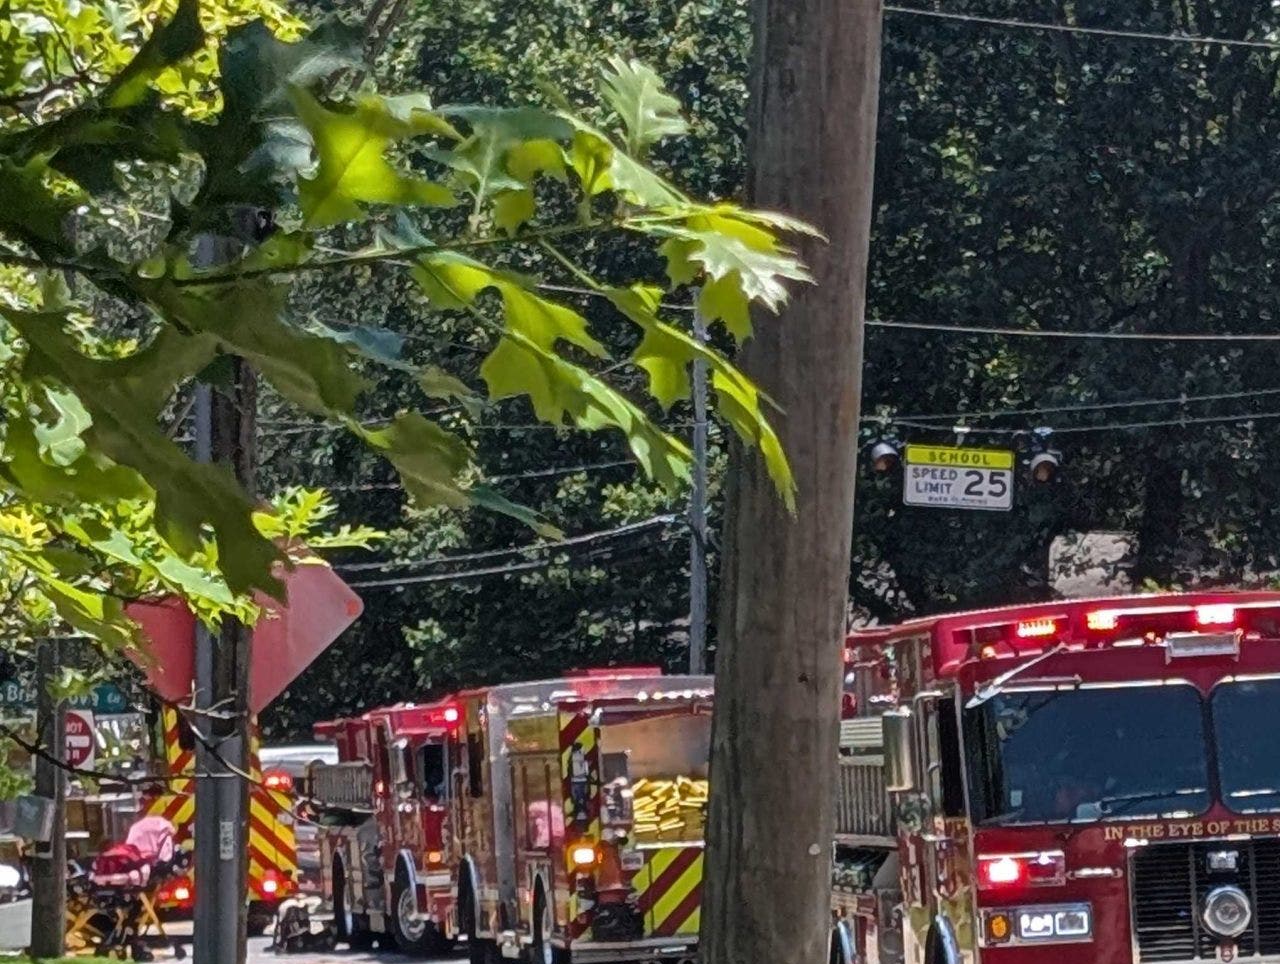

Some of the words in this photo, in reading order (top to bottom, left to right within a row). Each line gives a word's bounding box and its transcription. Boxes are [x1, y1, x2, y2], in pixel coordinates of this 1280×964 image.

[928, 451, 992, 465] SCHOOL
[912, 467, 958, 481] SPEED
[915, 481, 953, 495] LIMIT
[964, 470, 1007, 498] 25
[1104, 826, 1124, 841] IN
[1127, 824, 1164, 839] THE
[1168, 822, 1204, 837] EYE
[1207, 820, 1231, 835] OF
[1234, 818, 1270, 834] THE
